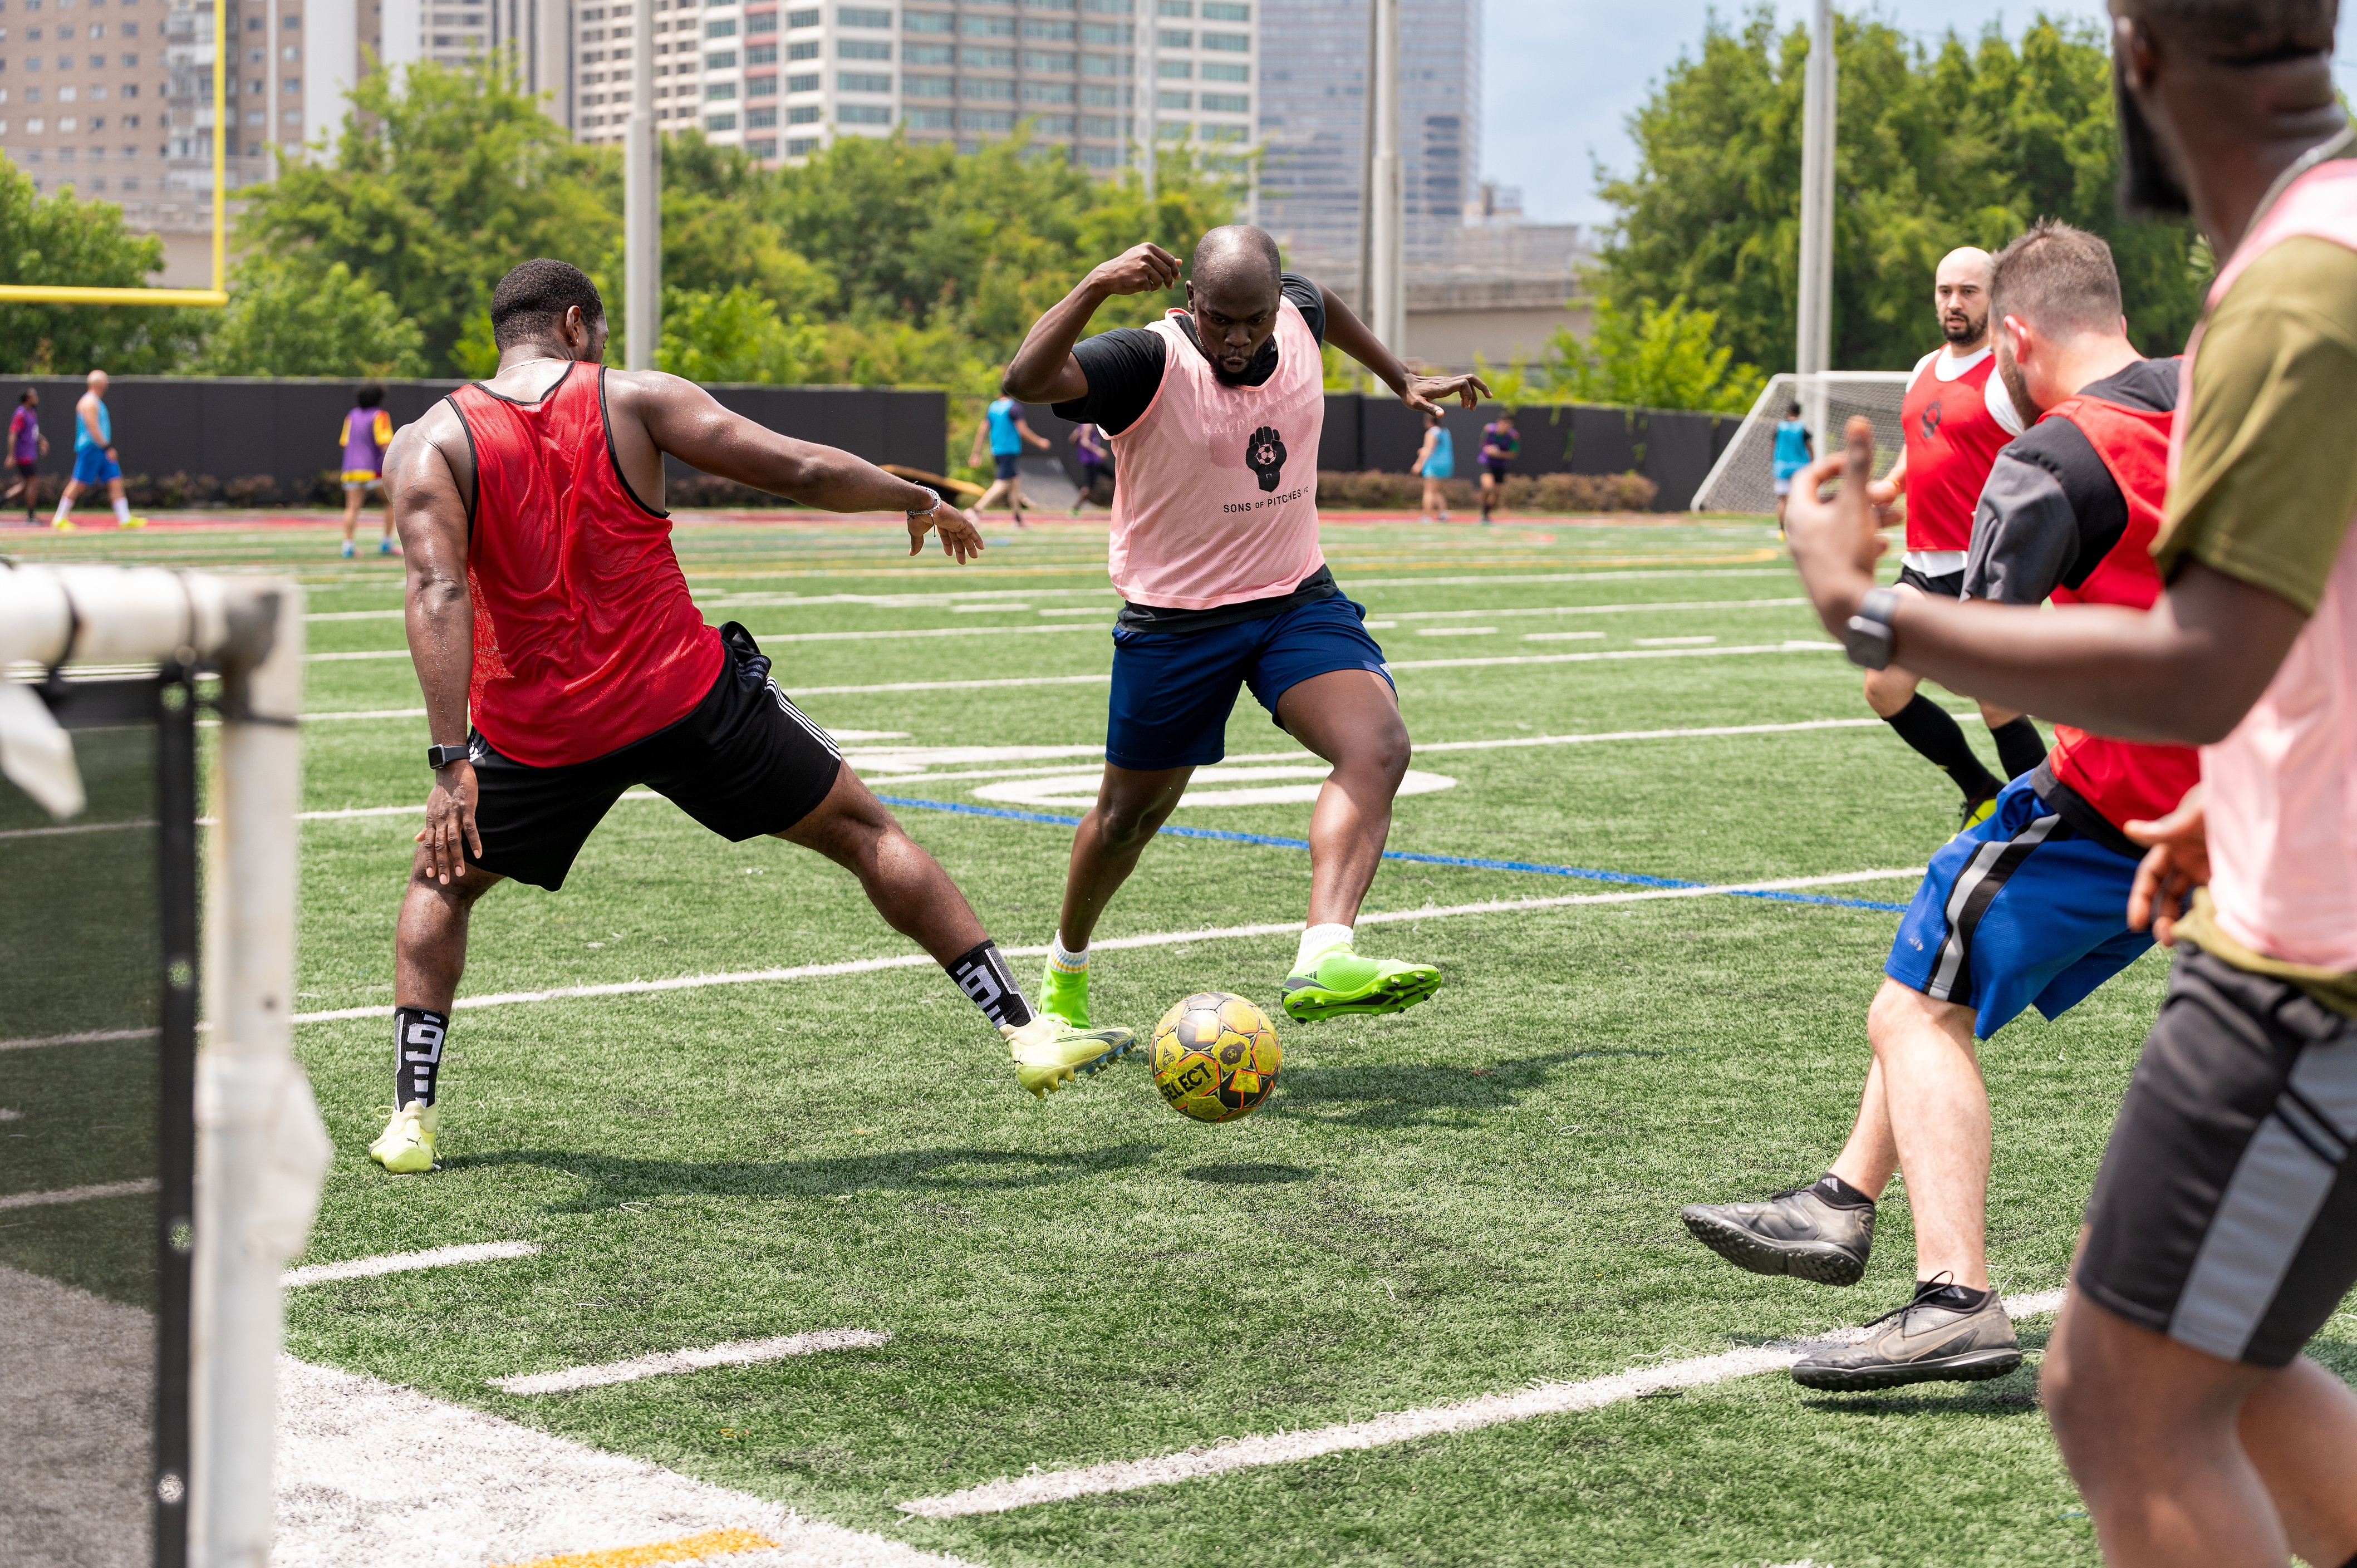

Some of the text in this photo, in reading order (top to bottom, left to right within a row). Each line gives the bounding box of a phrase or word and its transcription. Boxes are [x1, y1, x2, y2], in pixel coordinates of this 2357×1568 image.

[1224, 374, 1298, 415] POLO
[1223, 503, 1251, 513] SONS
[1268, 489, 1302, 508] PITCHES
[1162, 1056, 1176, 1067] SELECT
[1160, 1061, 1212, 1102] SELECT
